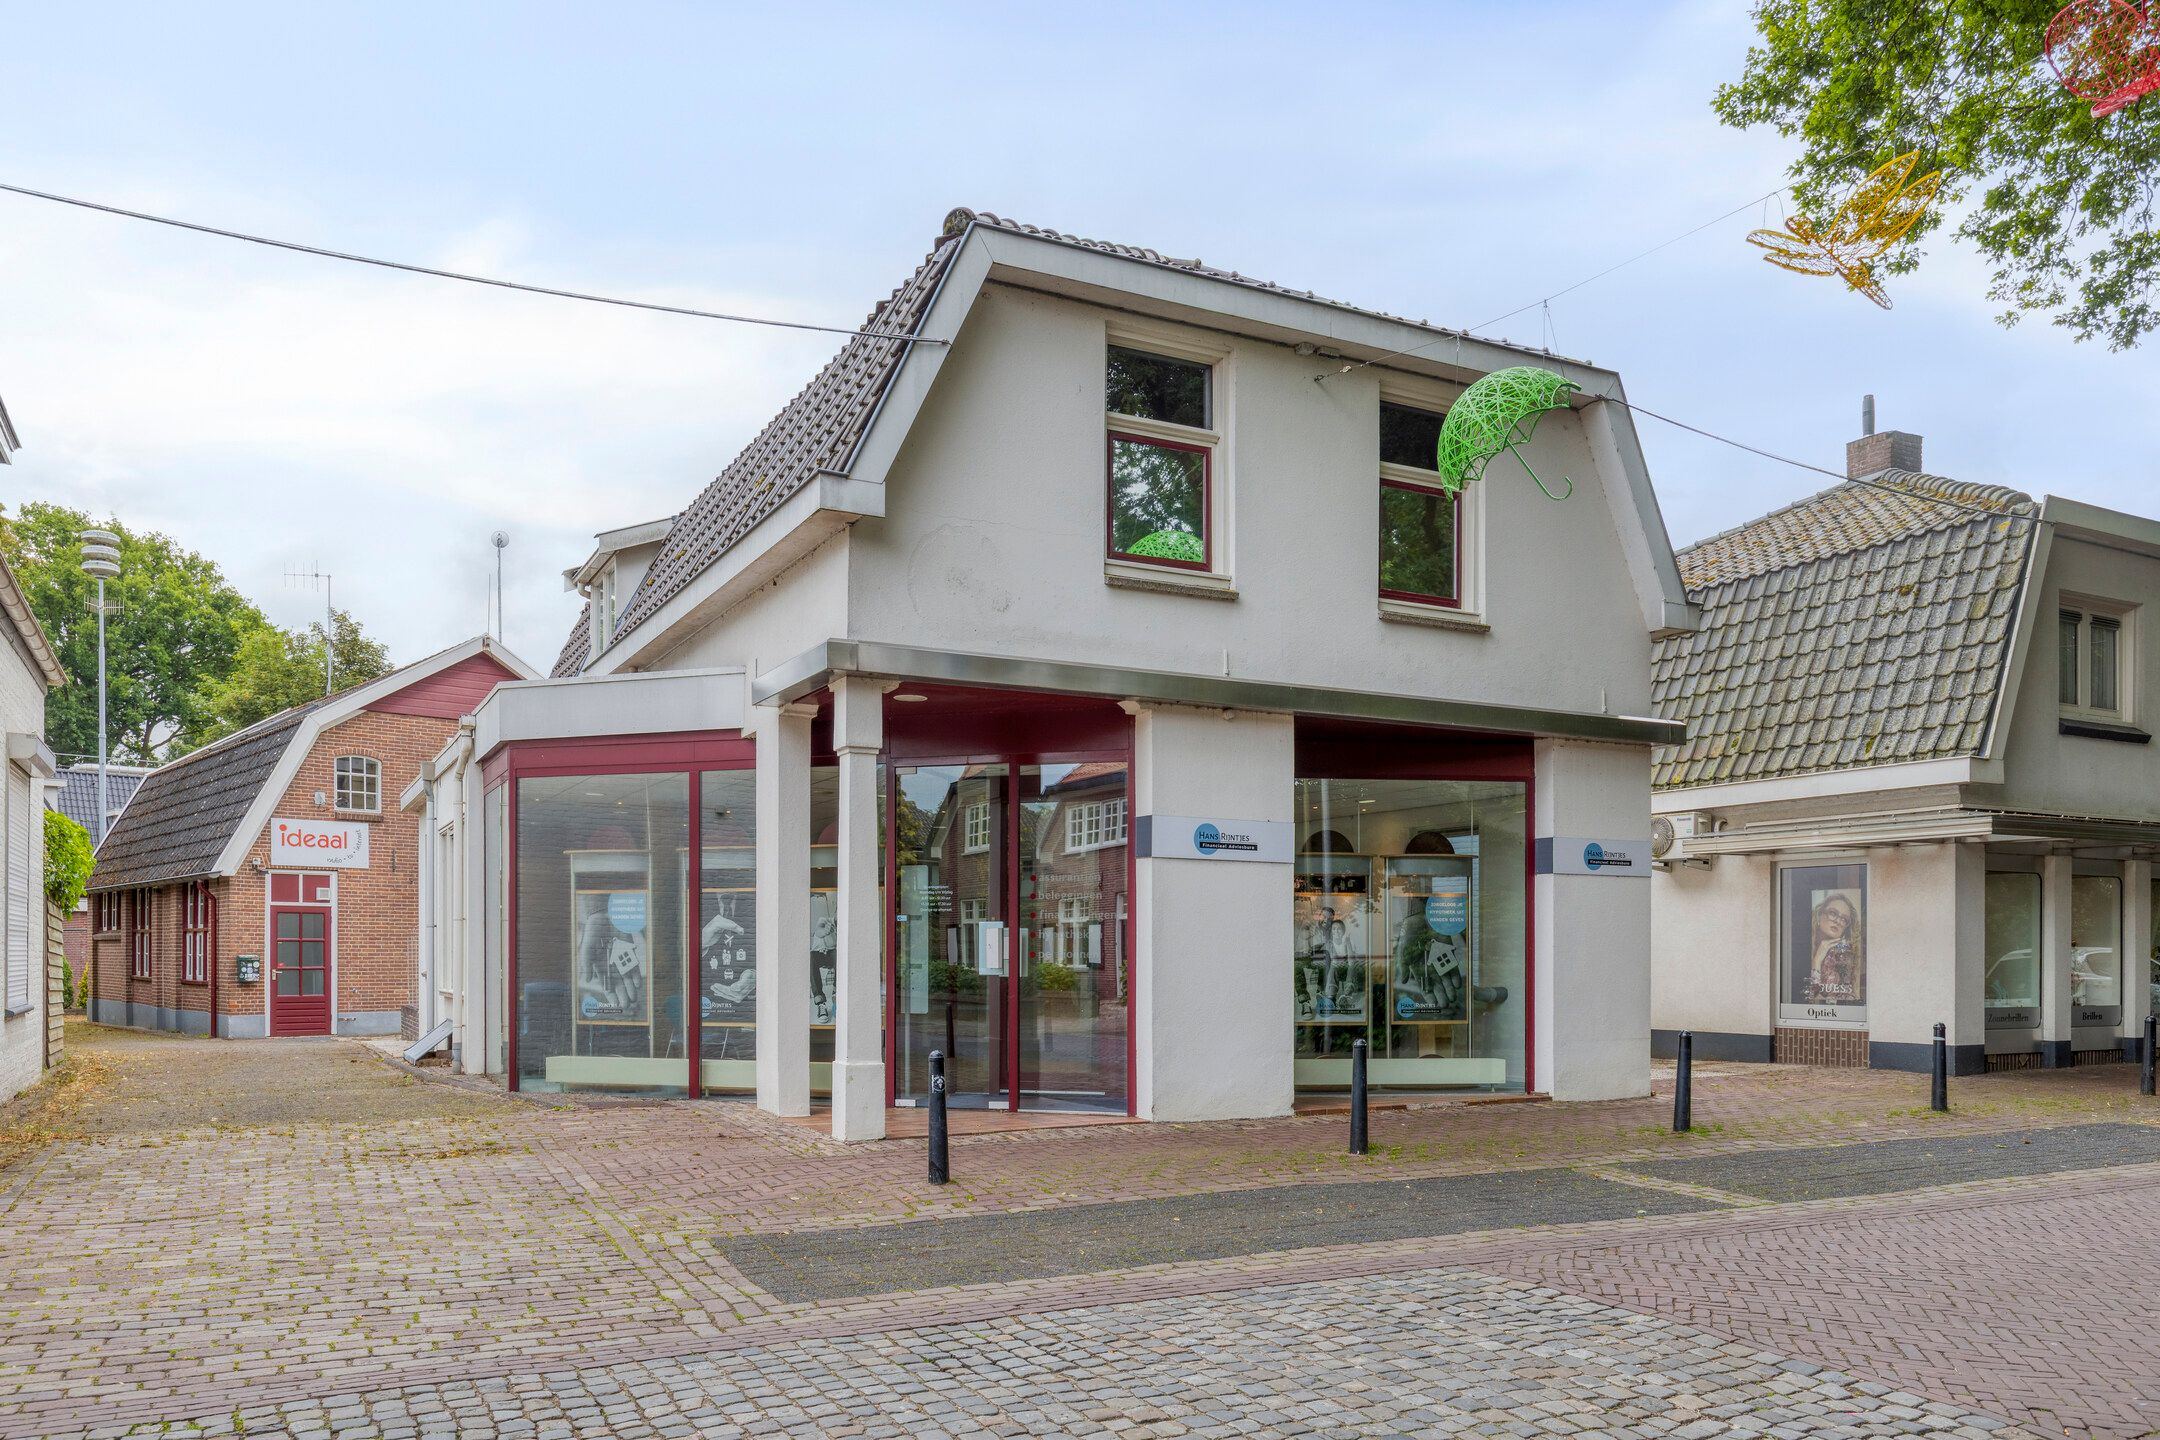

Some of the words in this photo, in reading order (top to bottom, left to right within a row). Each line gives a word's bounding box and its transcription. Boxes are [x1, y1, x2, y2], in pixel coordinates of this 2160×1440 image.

[279, 824, 347, 849] ideaal
[1199, 831, 1219, 841] HANS
[1040, 908, 1117, 922] finaingen
[2082, 1011, 2103, 1021] Brillen
